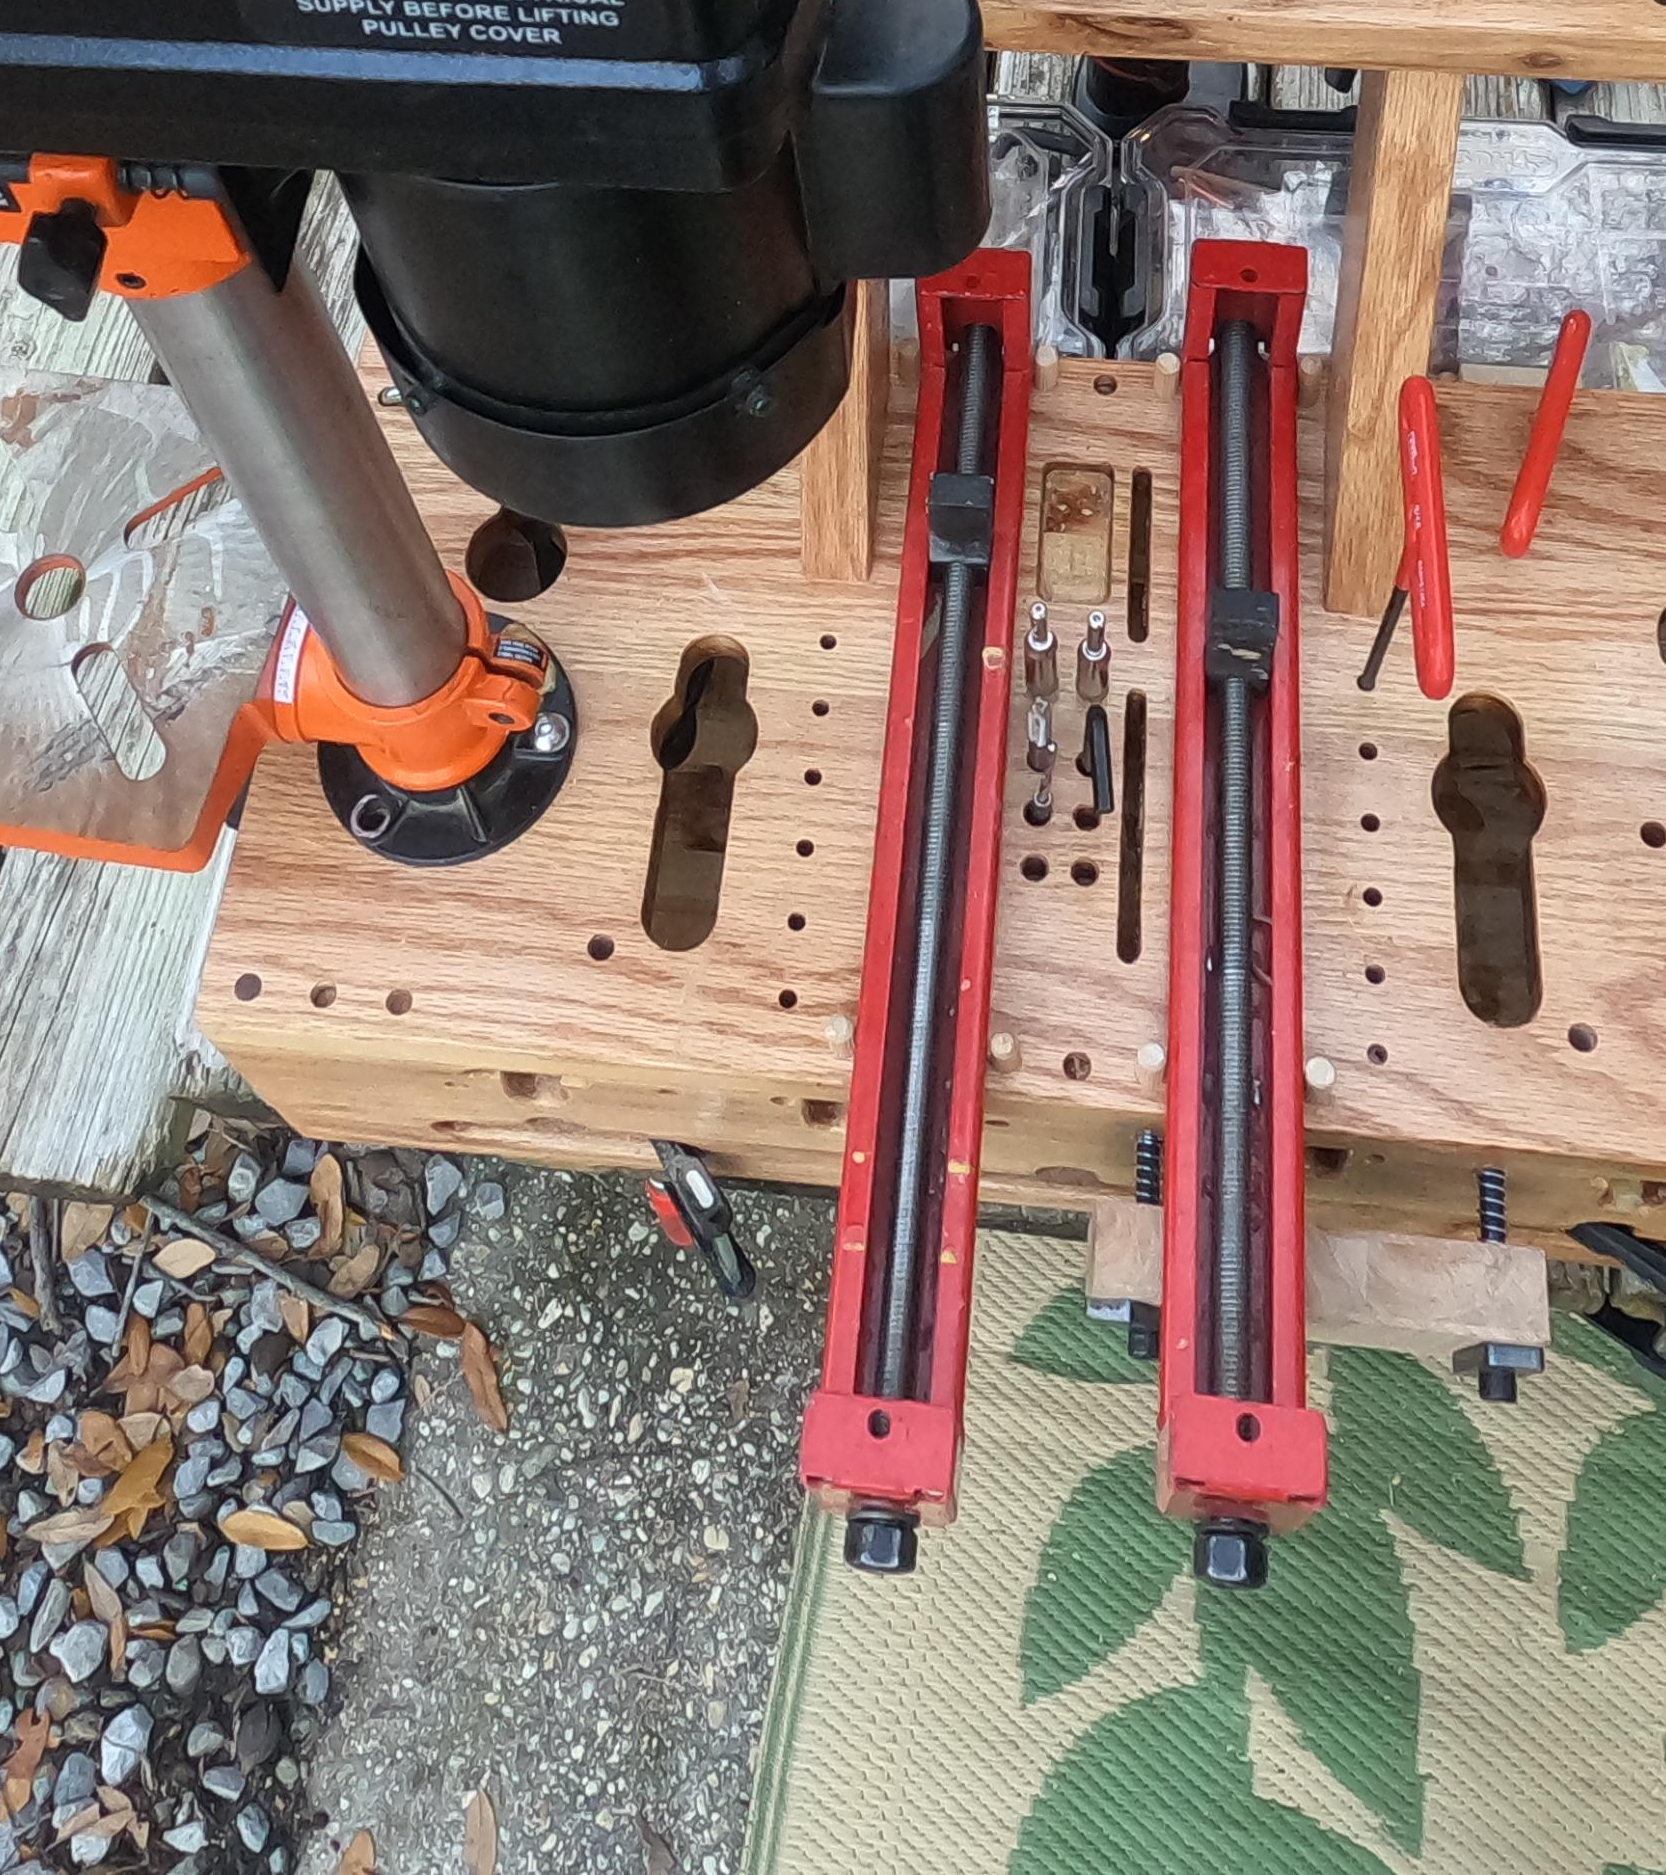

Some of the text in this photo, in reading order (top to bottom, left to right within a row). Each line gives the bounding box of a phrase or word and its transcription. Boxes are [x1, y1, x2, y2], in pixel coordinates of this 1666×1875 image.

[404, 0, 512, 23] BEFORE
[518, 6, 620, 27] LIFTING
[361, 18, 564, 45] PULLEY COVER
